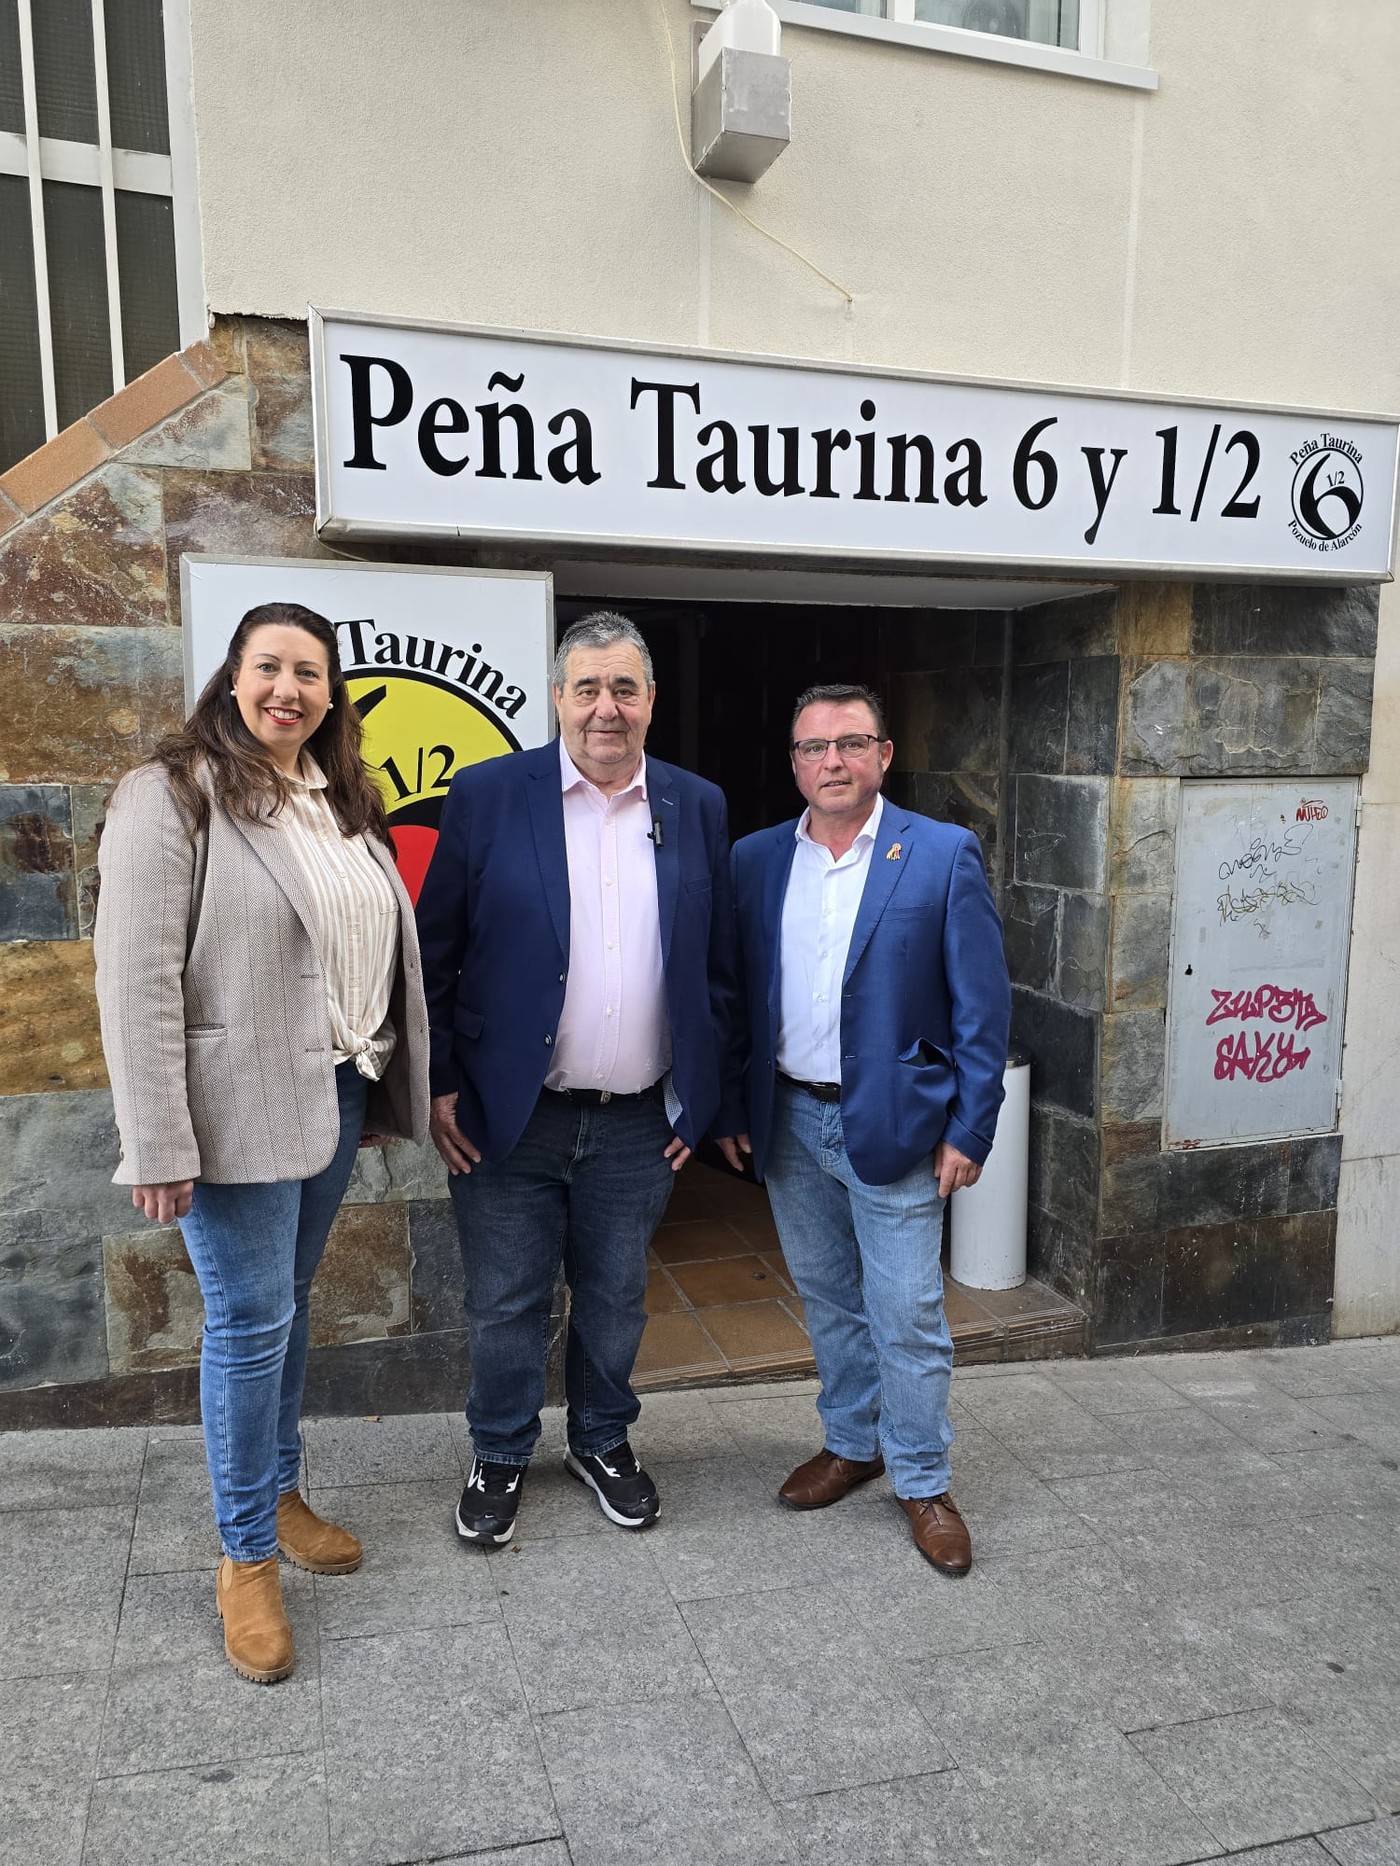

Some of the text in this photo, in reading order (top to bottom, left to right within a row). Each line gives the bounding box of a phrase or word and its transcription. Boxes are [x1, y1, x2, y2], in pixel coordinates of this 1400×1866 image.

[340, 355, 1260, 544] Peña Taurina 6 y 1/2
[1289, 433, 1363, 466] Peña Taurina
[1326, 470, 1345, 487] 1/2
[1288, 519, 1363, 552] Pozuelo de Alarcón
[334, 619, 527, 720] Taurina
[380, 744, 456, 801] 1/2
